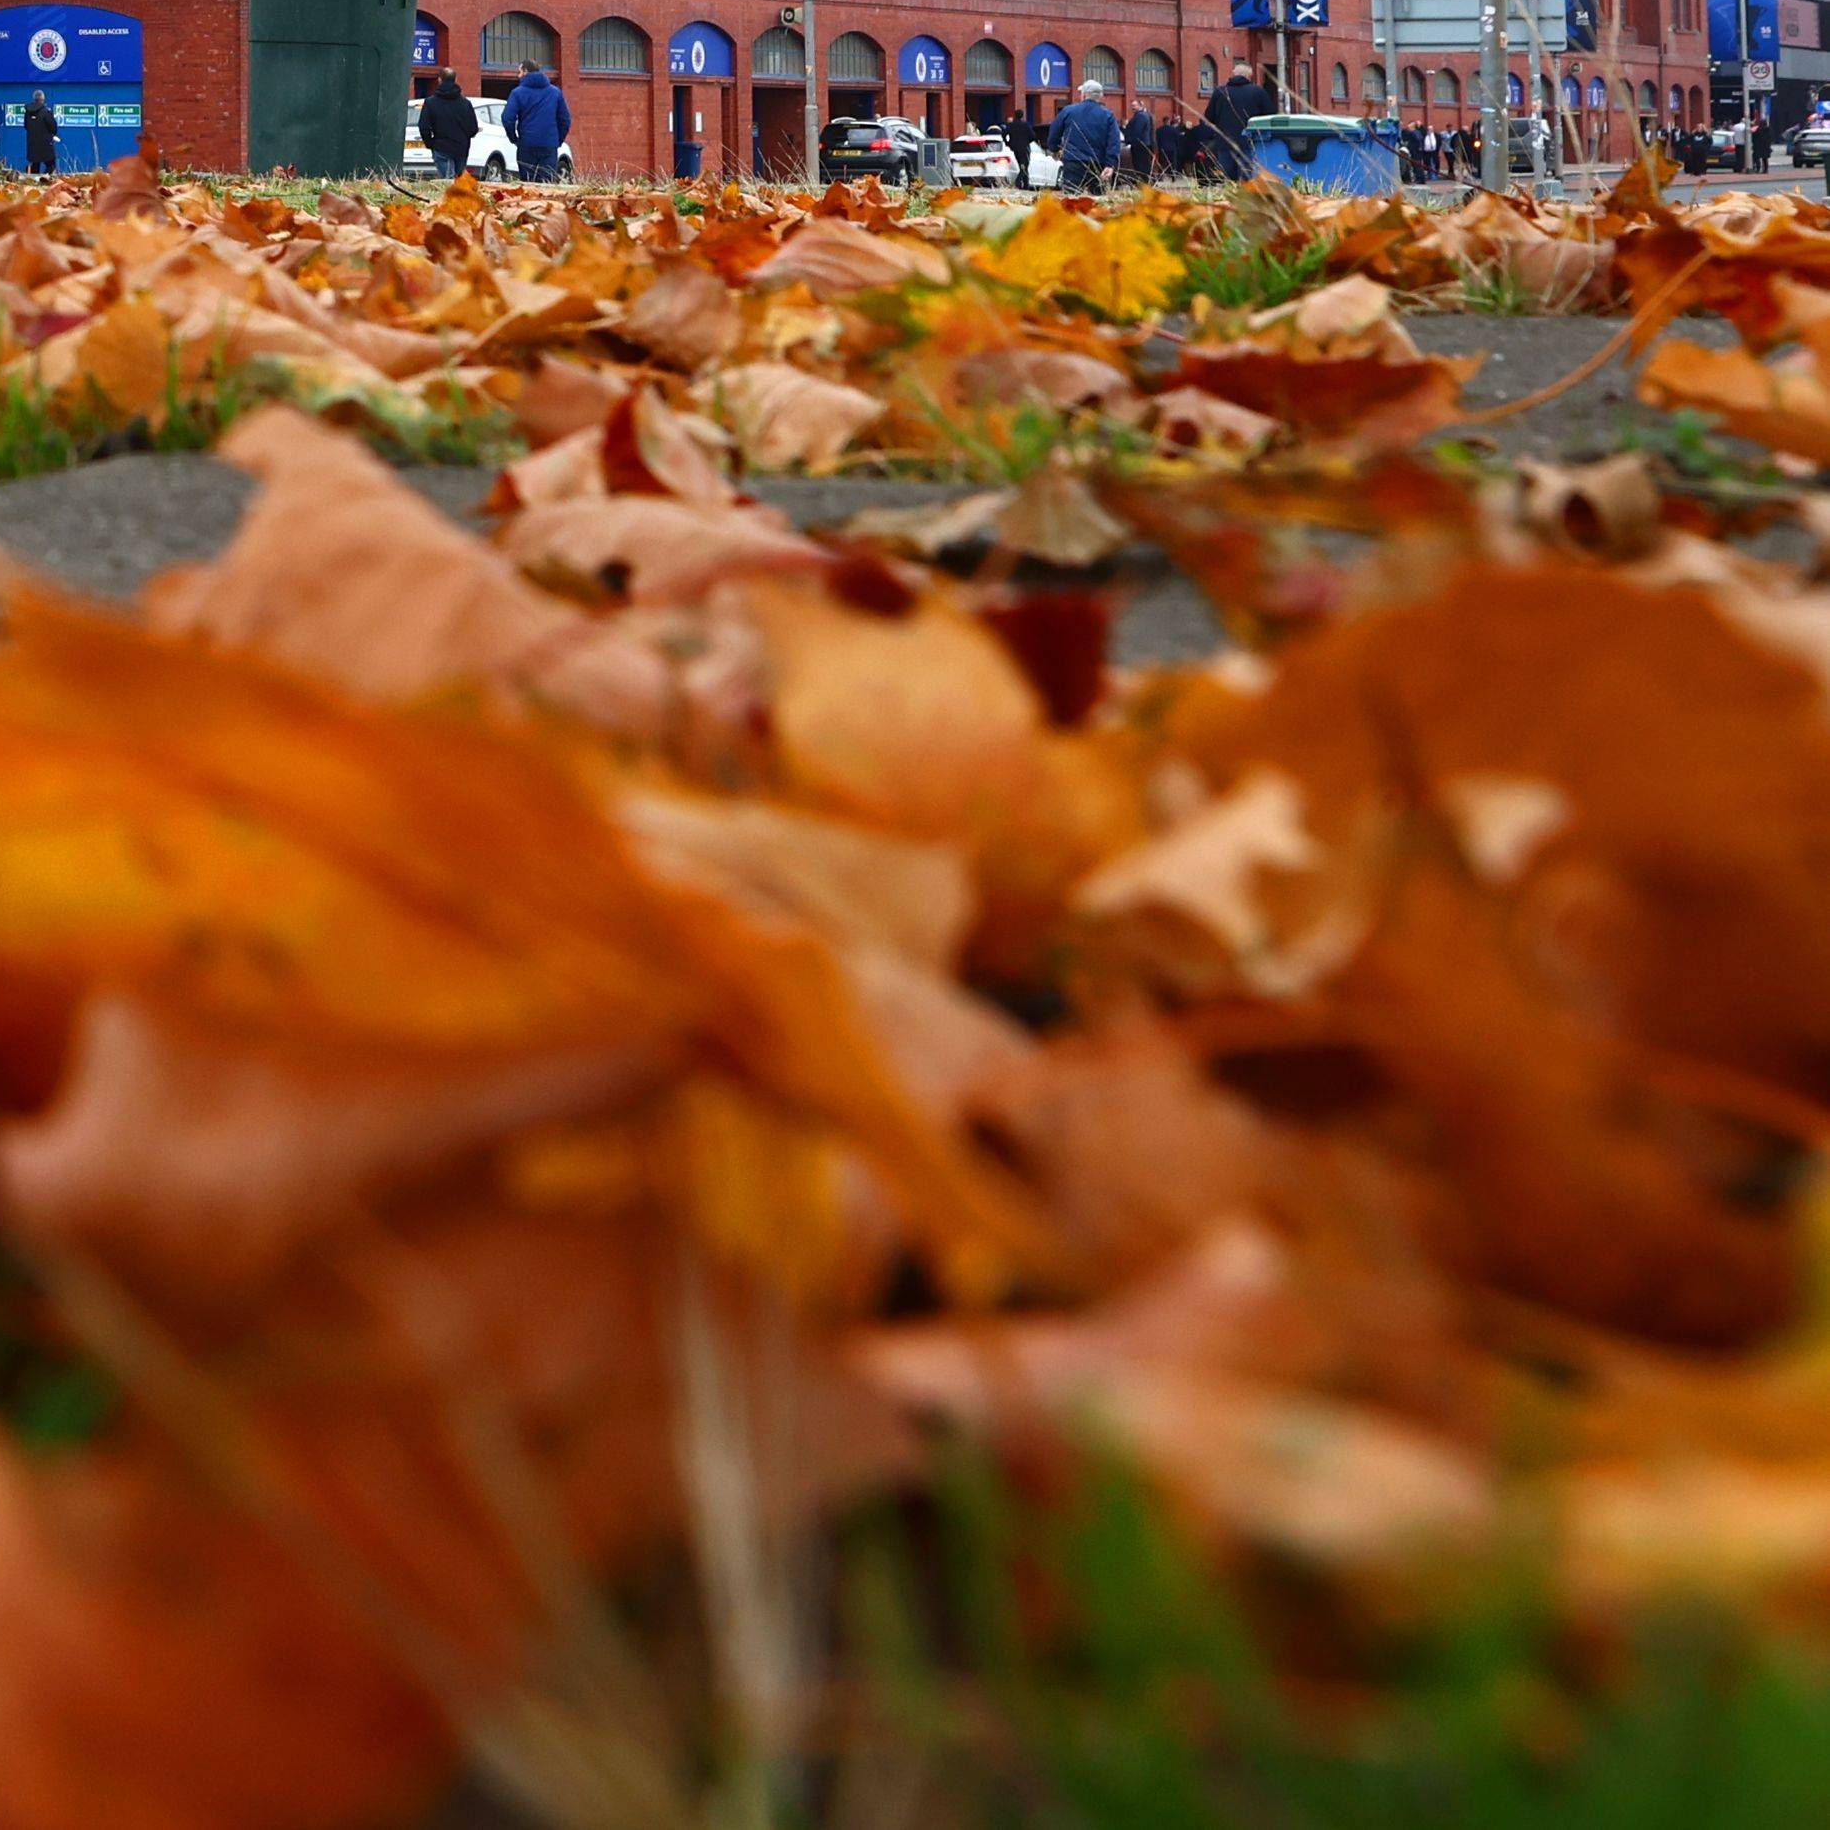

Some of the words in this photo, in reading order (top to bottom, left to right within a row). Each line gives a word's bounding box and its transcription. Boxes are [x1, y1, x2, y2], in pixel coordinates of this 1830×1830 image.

[78, 28, 106, 36] DISABLED
[413, 47, 423, 60] 42
[427, 48, 435, 60] 41
[1752, 64, 1769, 76] 20
